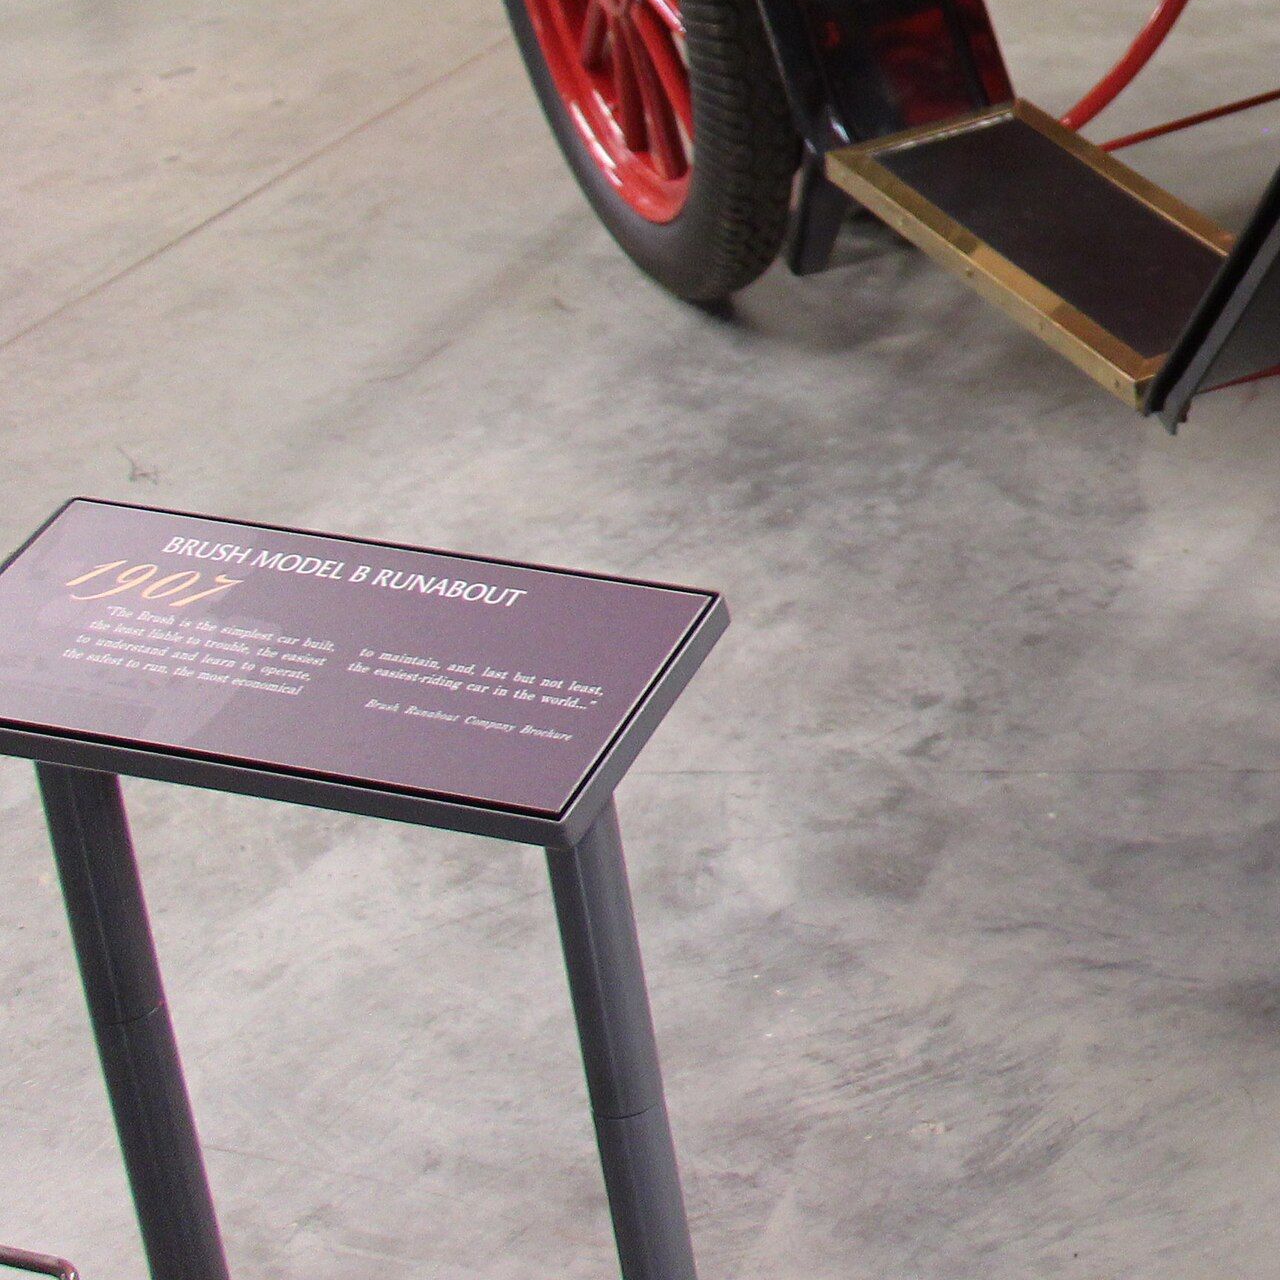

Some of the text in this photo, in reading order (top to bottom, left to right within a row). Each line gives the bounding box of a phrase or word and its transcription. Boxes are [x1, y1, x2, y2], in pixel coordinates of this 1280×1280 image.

[65, 559, 244, 607] 1907
[162, 536, 528, 607] BRUSH MODEL B RUNABOUT
[89, 620, 328, 665] the least liable to trouble, the easiest
[137, 610, 175, 625] Brush
[195, 621, 217, 631] the
[220, 625, 274, 640] simplest
[277, 636, 300, 645] car
[302, 637, 335, 652] built,
[62, 648, 304, 695] the safest to run, the most economical
[76, 634, 311, 681] to understand and learn to operate,
[359, 648, 375, 657] to
[378, 652, 441, 670] maintain,
[481, 667, 509, 680] last
[513, 672, 536, 684] but
[540, 678, 563, 689] not
[568, 681, 604, 696] least,
[347, 662, 371, 673] the
[373, 667, 463, 690] easiest-riding
[466, 683, 490, 693] car
[492, 685, 508, 696] in
[513, 689, 536, 701] the
[365, 698, 574, 741] Brush Runabout Company Brochure
